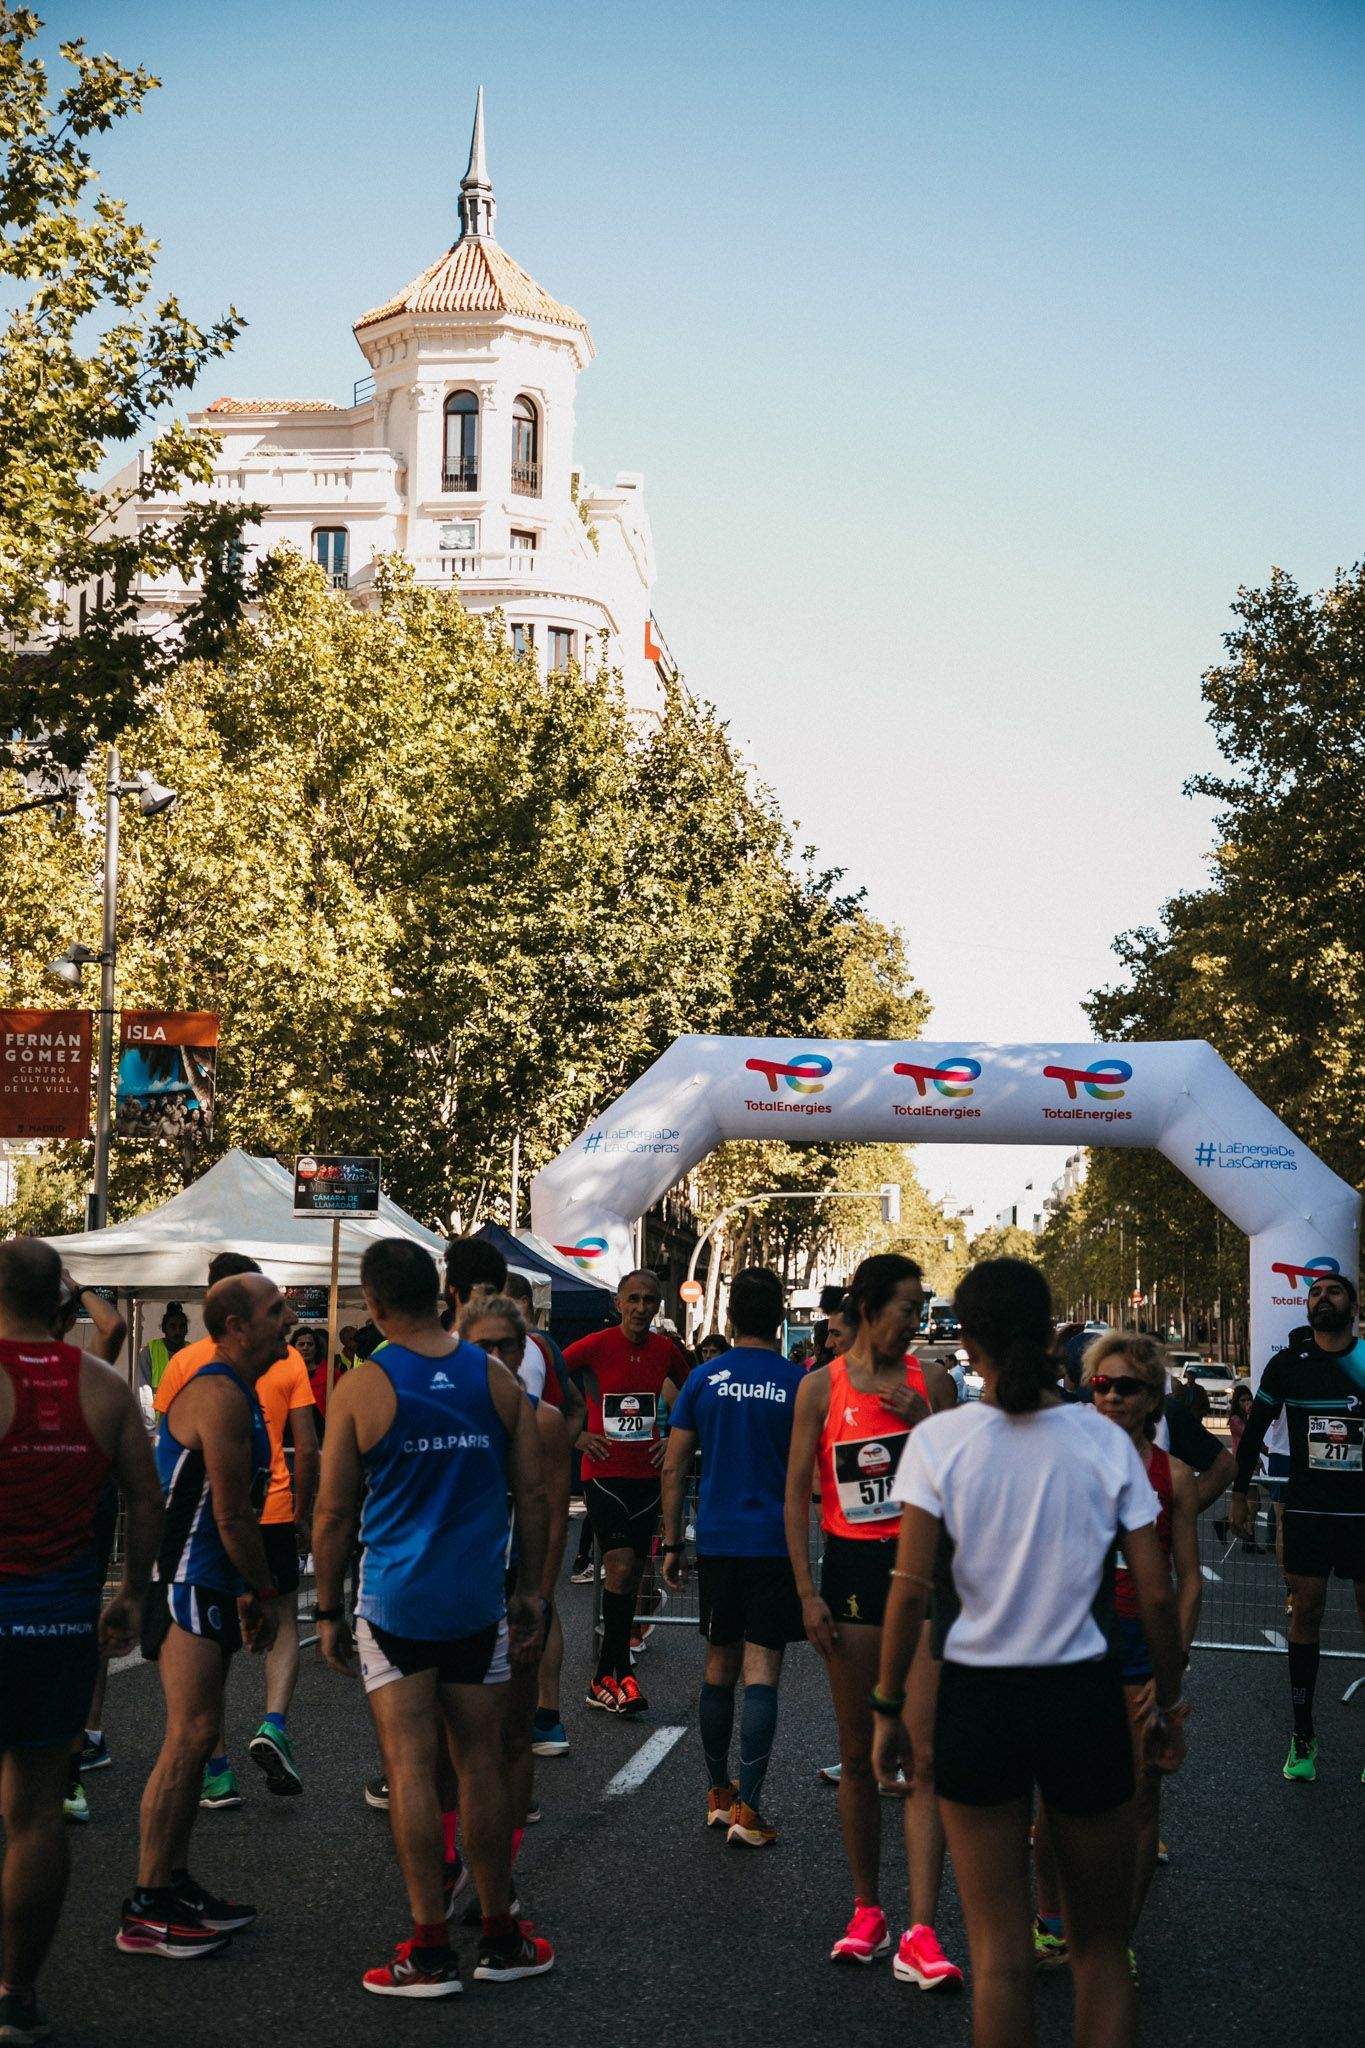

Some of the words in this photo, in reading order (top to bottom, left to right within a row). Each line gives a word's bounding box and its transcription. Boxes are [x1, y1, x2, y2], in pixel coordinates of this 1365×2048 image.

[5, 1031, 80, 1047] FERNÁN
[127, 1025, 166, 1040] ISLA
[5, 1047, 81, 1062] GÓMEZ
[20, 1066, 66, 1074] CENTRO
[13, 1076, 72, 1084] CULTURAL
[4, 1085, 18, 1093] DE
[25, 1085, 39, 1093] LA
[744, 1100, 832, 1115] TotalEnergies
[892, 1105, 981, 1120] TotalEnergies
[1042, 1108, 1133, 1123] TotalEnergies
[1218, 1156, 1298, 1170] LasCarreras
[717, 1382, 787, 1403] aqualia
[618, 1417, 643, 1432] 220
[1324, 1443, 1349, 1461] 217
[12, 1624, 93, 1636] MARATHON
